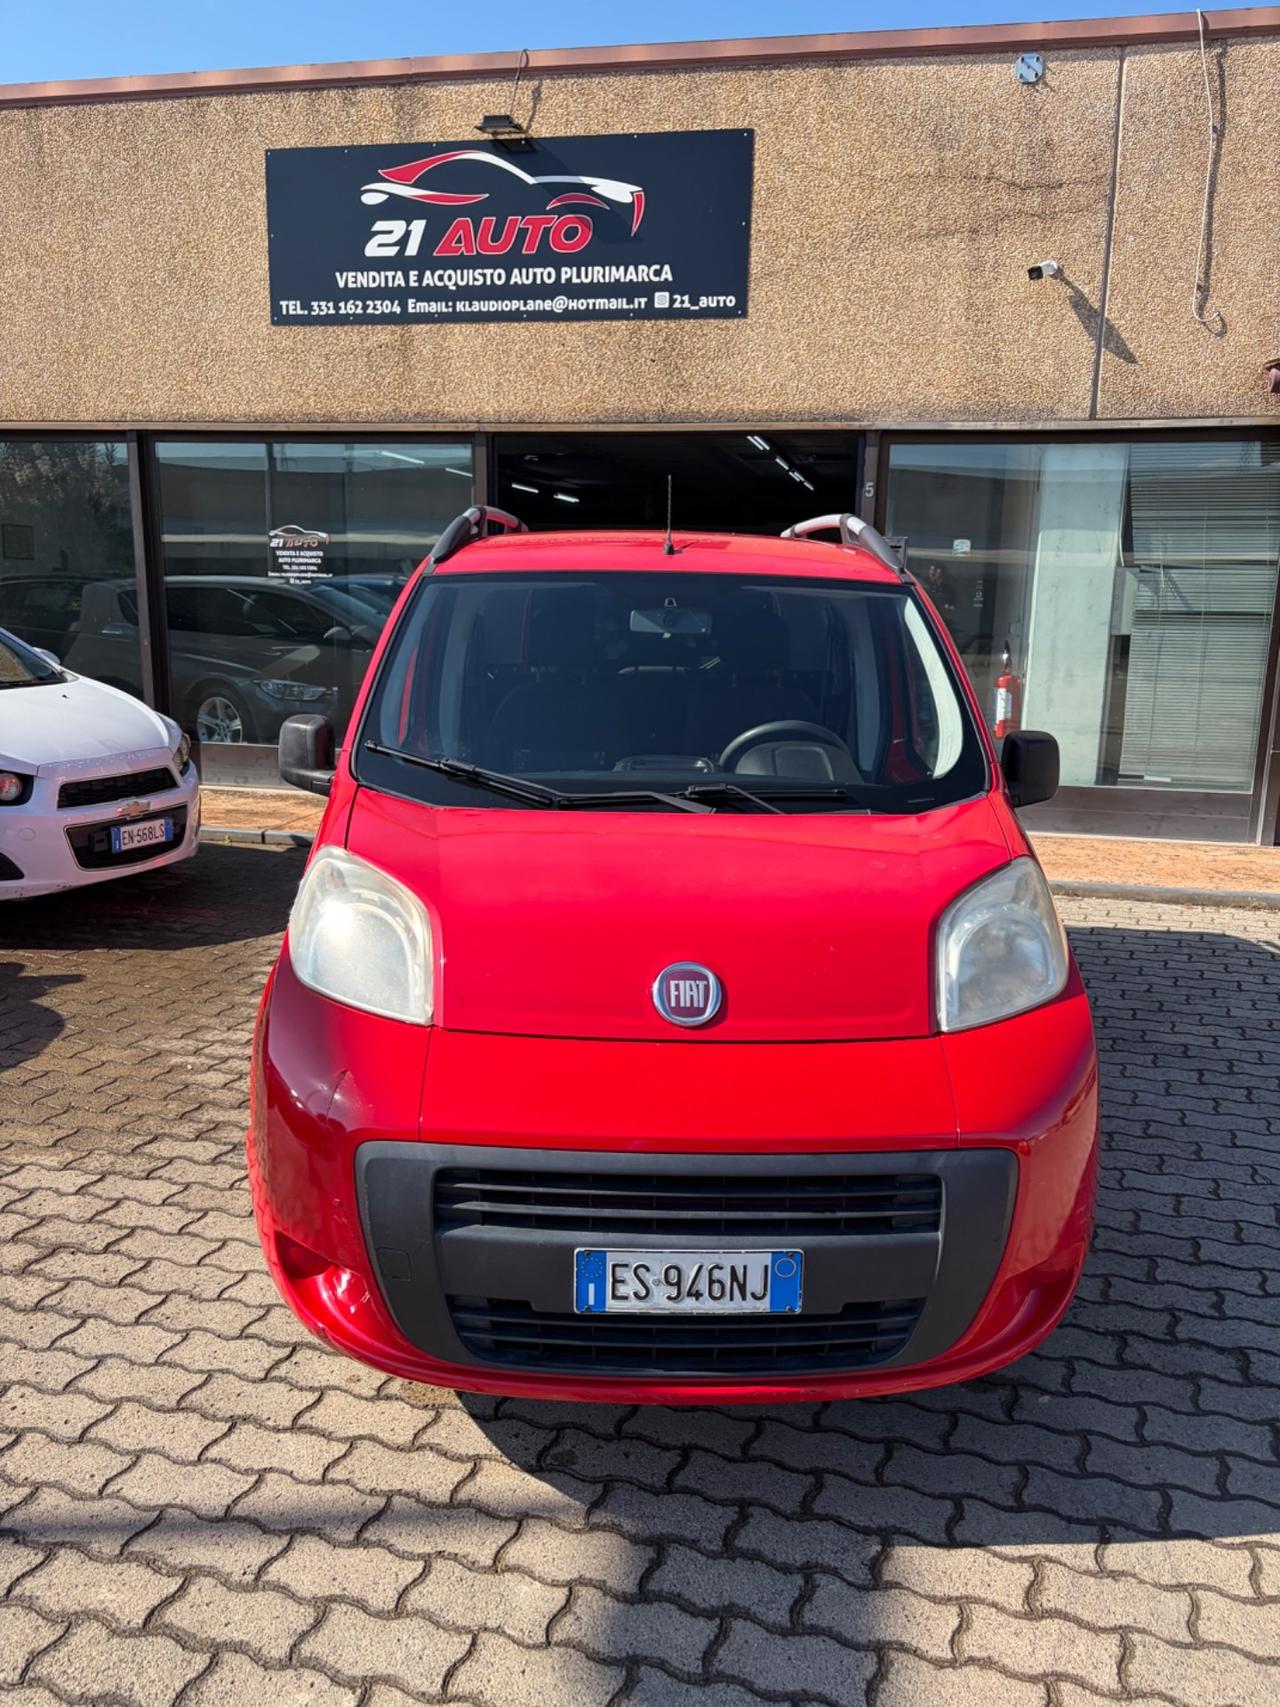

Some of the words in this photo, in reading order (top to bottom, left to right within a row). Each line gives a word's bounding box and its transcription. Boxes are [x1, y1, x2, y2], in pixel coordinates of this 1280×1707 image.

[364, 219, 427, 257] 21
[433, 214, 593, 256] AUTO
[335, 271, 406, 288] VENDITA
[409, 270, 419, 287] E
[422, 268, 507, 290] ACQUISTO
[509, 267, 556, 285] AUTO
[561, 264, 673, 284] PLURIMARCA
[279, 300, 308, 315] TEL.
[310, 301, 336, 315] 331
[338, 300, 363, 315] 162
[366, 300, 401, 315] 2304
[865, 481, 875, 497] 5
[270, 538, 284, 547] 21
[670, 980, 708, 1008] FIAT
